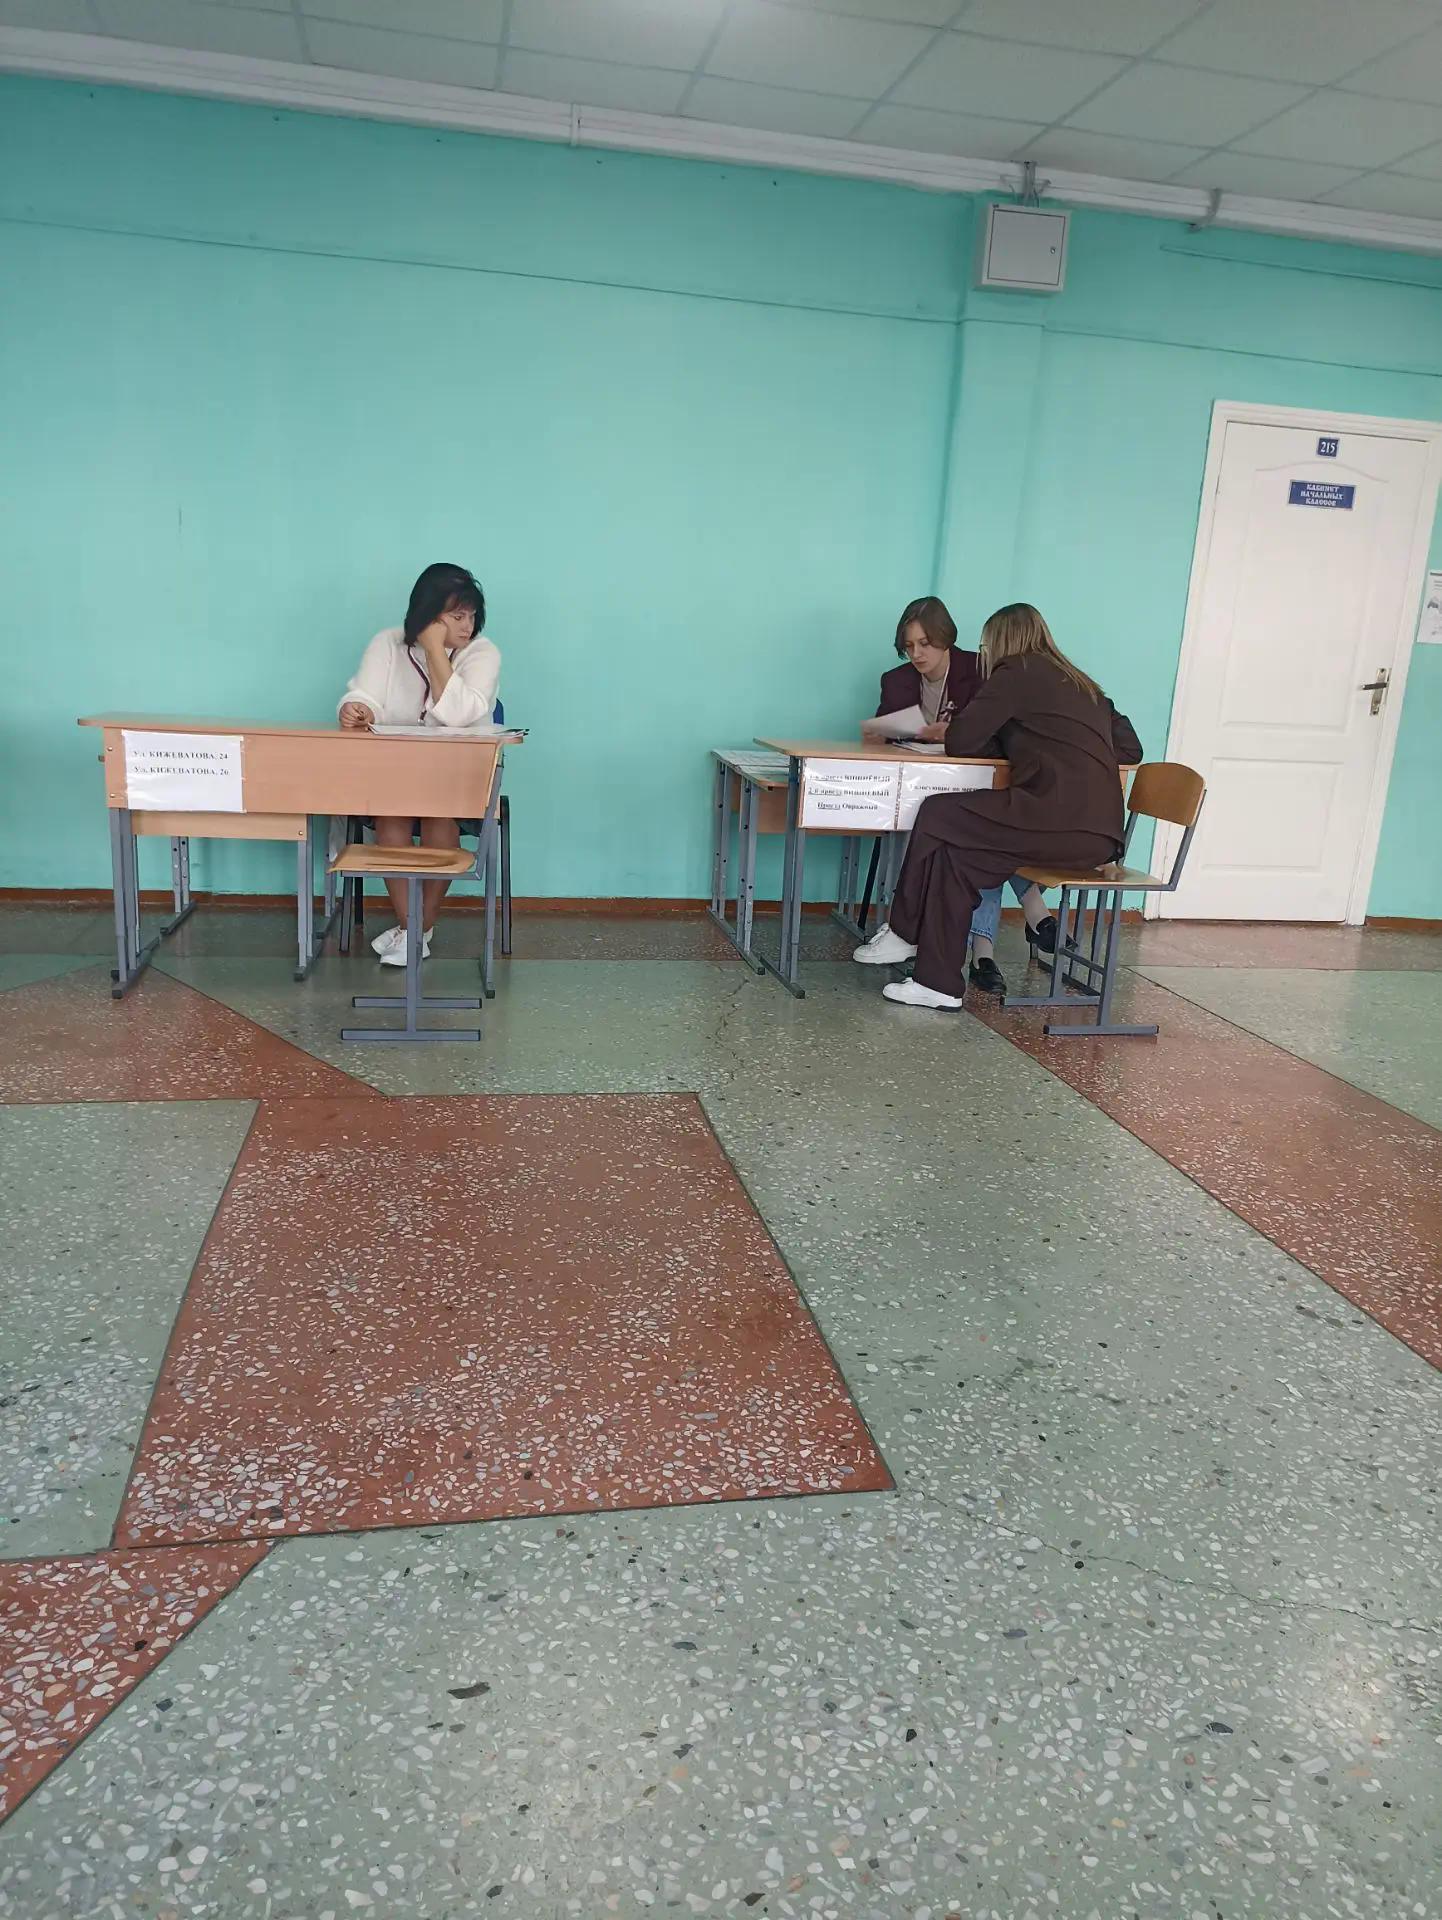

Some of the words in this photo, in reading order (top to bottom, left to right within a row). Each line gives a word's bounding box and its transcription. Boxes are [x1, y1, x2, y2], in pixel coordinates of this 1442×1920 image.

[1320, 441, 1336, 453] 215
[1306, 483, 1341, 493] КАБИНЕТ
[1300, 490, 1344, 500] НАЧАЛЬНЫХ
[1305, 497, 1337, 506] КЛАССОВ
